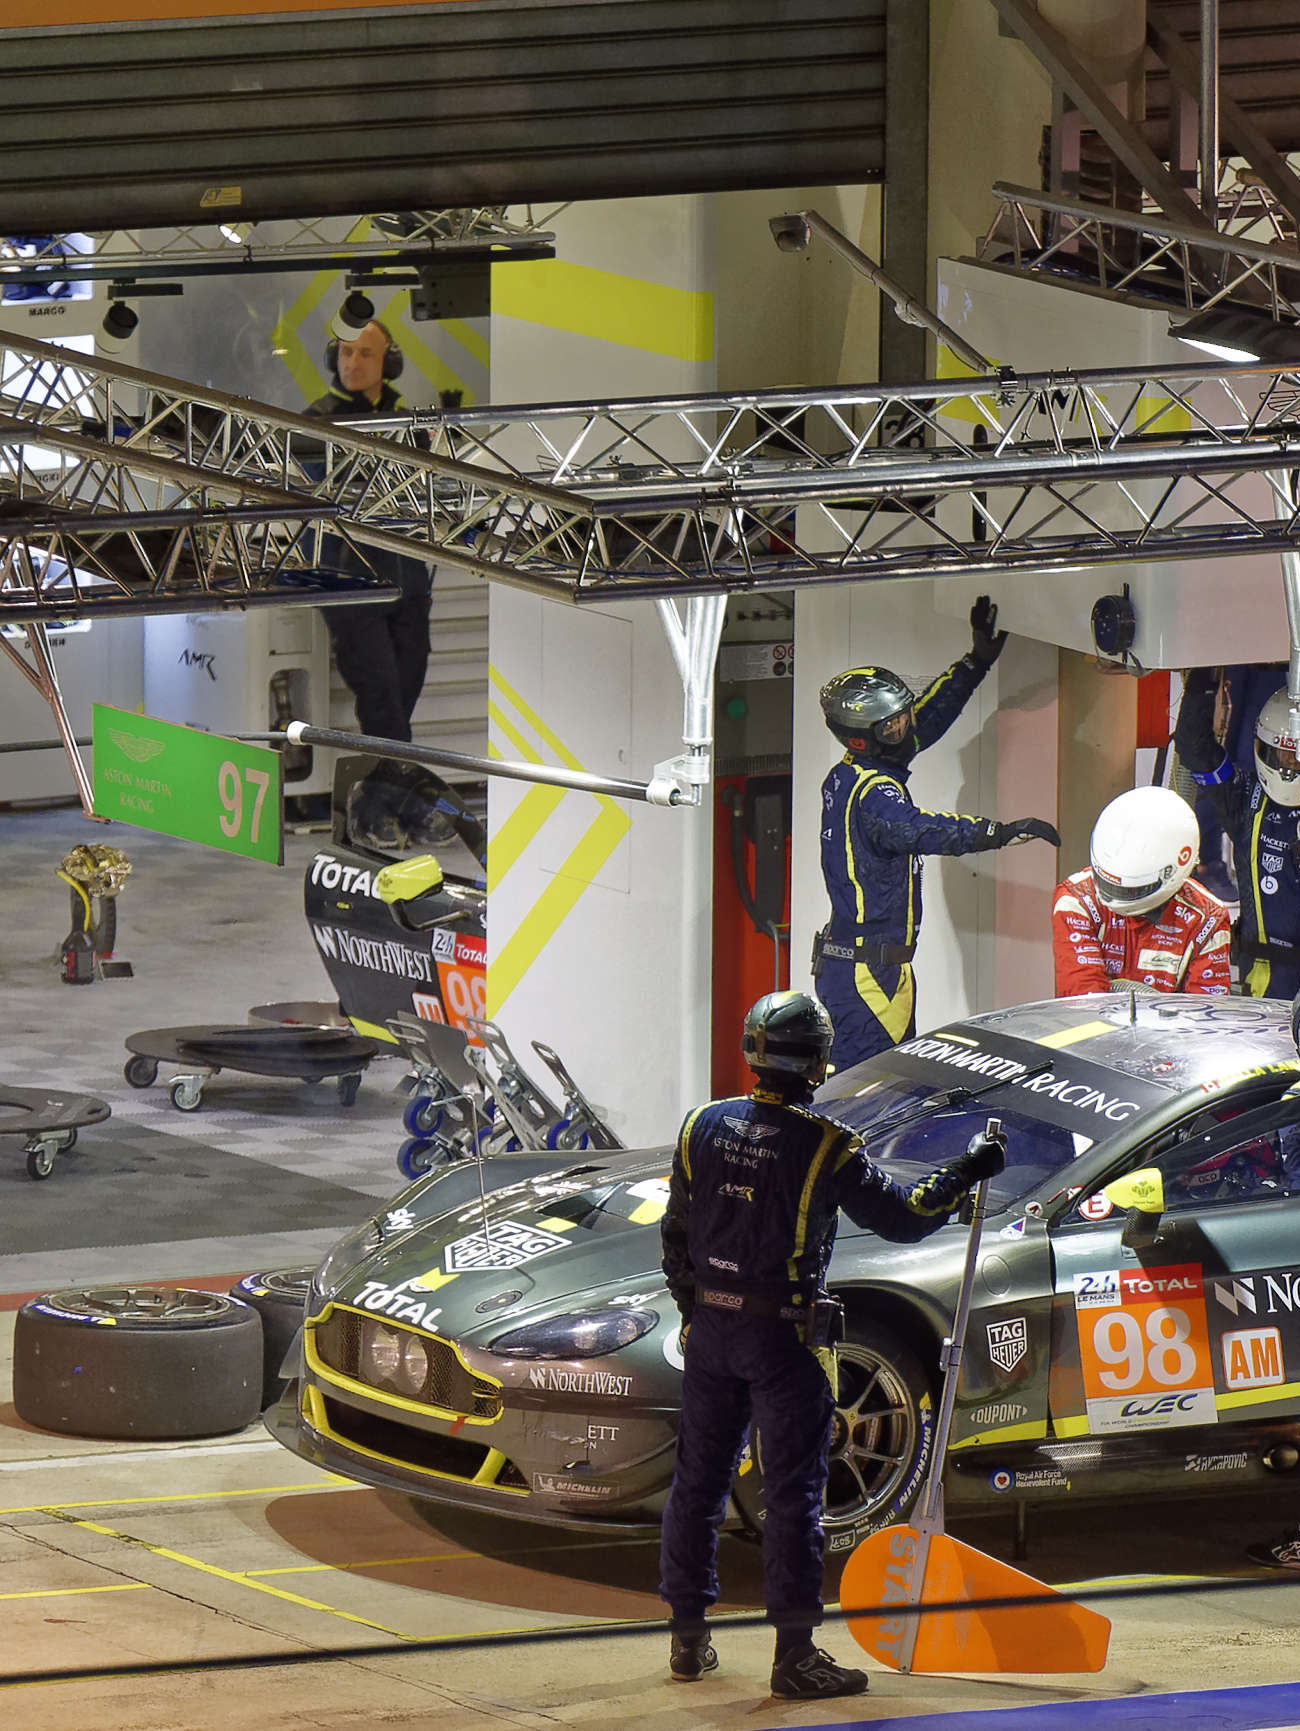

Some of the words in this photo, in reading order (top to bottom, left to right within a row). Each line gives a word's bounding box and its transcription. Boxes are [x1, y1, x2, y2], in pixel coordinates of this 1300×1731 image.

[218, 760, 270, 844] 97
[1173, 906, 1196, 924] sky
[895, 1038, 951, 1062] ASTON
[1022, 1071, 1141, 1122] RACING
[491, 1224, 561, 1253] TAG
[1122, 1277, 1198, 1295] TOTAL
[352, 1281, 443, 1333] TOTAL
[990, 1322, 1023, 1342] TAG
[991, 1340, 1025, 1368] HEUER
[1093, 1306, 1197, 1390] 98
[1230, 1336, 1280, 1382] AM
[976, 1404, 1022, 1425] DUPONT
[1120, 1393, 1198, 1417] WEC
[899, 1426, 932, 1508] MICHELIN
[1015, 1471, 1034, 1482] Royal
[1034, 1471, 1042, 1480] Air
[1043, 1470, 1062, 1479] Force
[1015, 1477, 1052, 1488] Benevolent
[1053, 1477, 1067, 1486] Fund
